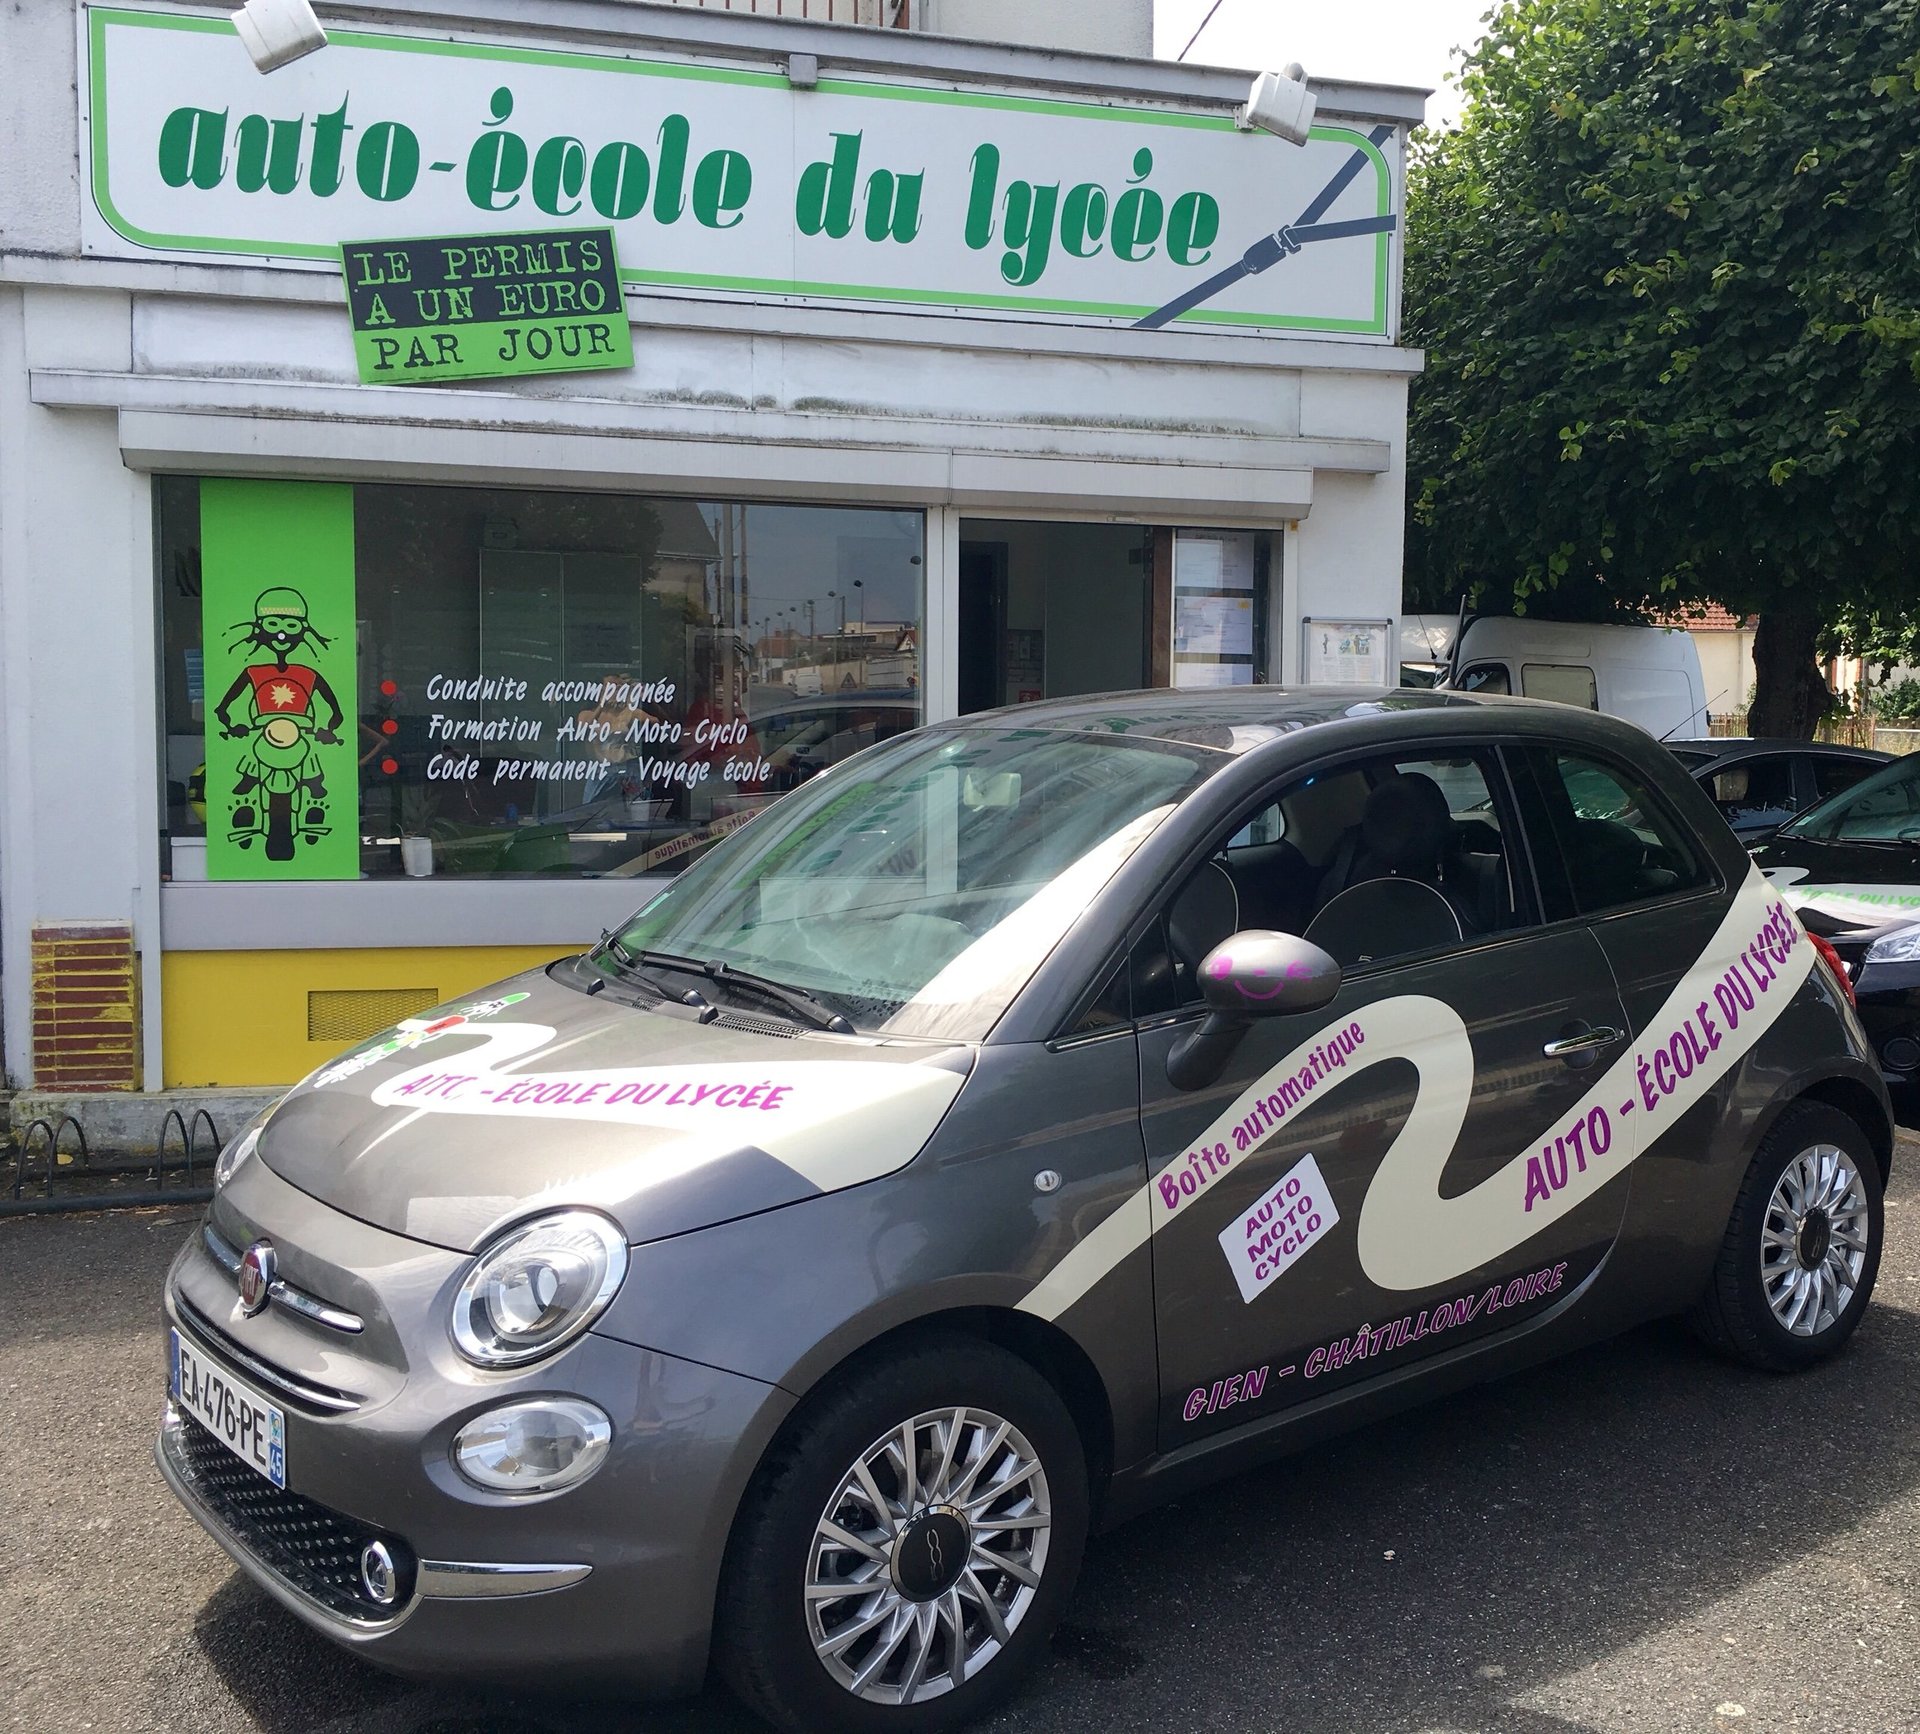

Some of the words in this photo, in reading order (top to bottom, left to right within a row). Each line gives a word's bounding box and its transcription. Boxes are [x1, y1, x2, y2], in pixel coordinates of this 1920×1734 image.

[157, 86, 753, 229] auto-école
[796, 129, 925, 244] du
[964, 142, 1220, 287] lycée
[353, 251, 412, 287] LE
[443, 239, 602, 280] PERMIS
[364, 294, 397, 325] A
[417, 288, 474, 320] UN
[499, 279, 606, 315] EURO
[372, 333, 465, 370] PAR
[498, 323, 615, 363] JOUR
[427, 674, 528, 703] Conduite
[541, 679, 676, 711] accompagnée
[428, 714, 542, 743] Formation
[427, 755, 478, 781] Code
[493, 757, 609, 788] permanent
[639, 755, 710, 790] Voyage
[723, 755, 772, 783] école
[1524, 1106, 1612, 1213] AUTO
[1636, 1001, 1723, 1112] ÉCOLE
[1713, 964, 1756, 1031] DU
[1741, 901, 1798, 993] LYCÉE
[492, 1077, 611, 1105] ÉCOLE
[604, 1083, 669, 1106] DU
[668, 1080, 795, 1111] LYCÉE
[1158, 1151, 1231, 1209] Boîte
[1231, 1022, 1365, 1152] automatique
[1245, 1178, 1301, 1239] AUTO
[1247, 1195, 1313, 1262] MOTO
[1255, 1213, 1322, 1281] CYCLO
[1183, 1365, 1270, 1421] GIEN
[1303, 1261, 1568, 1379] CHÂTILLON/LOIRE
[180, 1348, 267, 1467] EA-476-PE
[270, 1448, 283, 1479] 45
